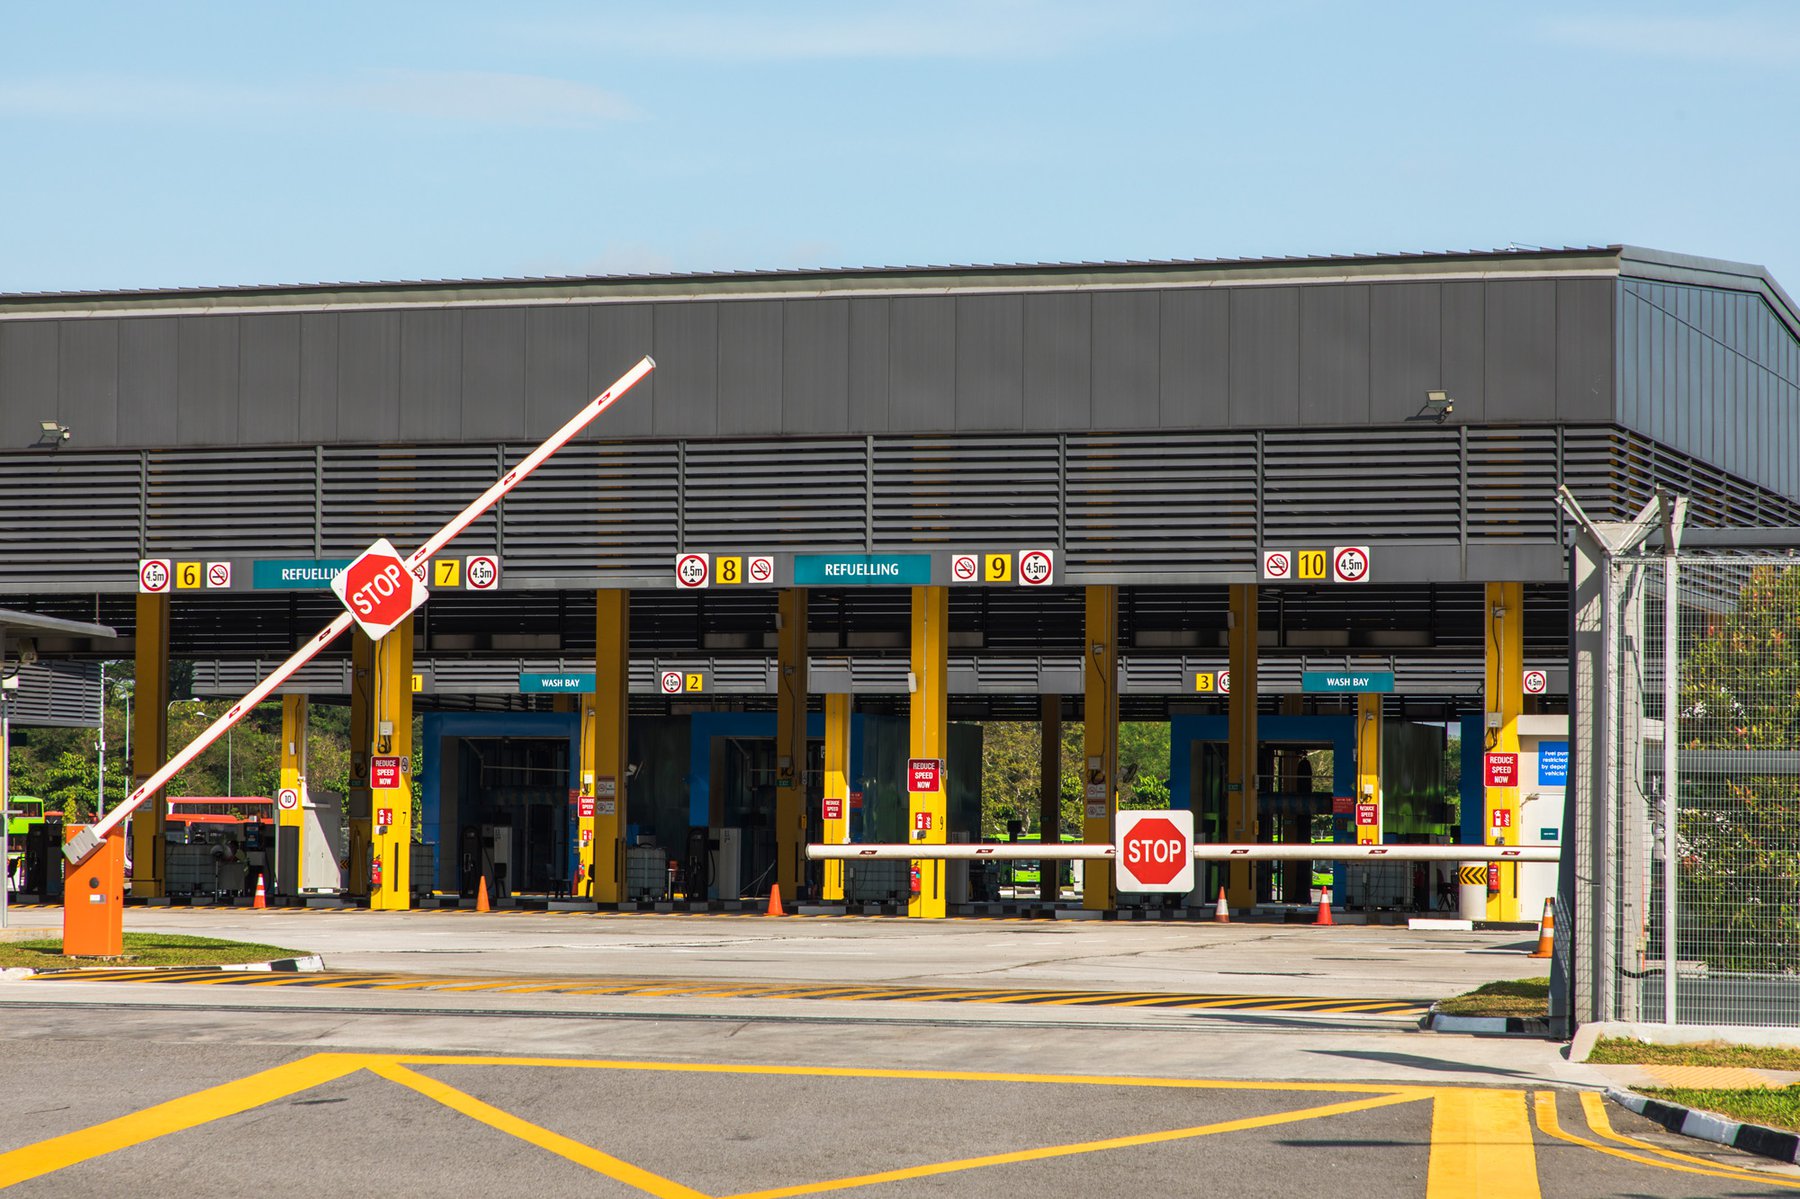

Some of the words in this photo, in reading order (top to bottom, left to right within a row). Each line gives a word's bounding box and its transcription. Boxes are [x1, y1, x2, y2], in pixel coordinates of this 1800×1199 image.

[722, 560, 736, 581] 8
[825, 563, 899, 576] REFUELLING
[992, 557, 1006, 579] 9
[1026, 562, 1047, 574] 4.5m
[1301, 554, 1324, 576] 10
[1341, 559, 1363, 570] 4.5m
[146, 568, 165, 582] 4.5m
[183, 565, 195, 586] 6
[281, 568, 343, 580] REFUELLIN
[441, 563, 454, 583] 7
[472, 567, 492, 579] 4.5m
[682, 565, 703, 577] 4.5m
[352, 564, 401, 615] STOP
[541, 679, 564, 687] WASH
[566, 679, 580, 687] BAY
[690, 675, 699, 689] 2
[1200, 675, 1209, 690] 3
[1327, 678, 1350, 687] WASH
[1353, 678, 1369, 687] BAY
[1528, 679, 1543, 687] 4.5m
[913, 762, 935, 770] REDUCE
[1489, 756, 1514, 764] REDUCE
[1491, 766, 1512, 774] SPEED
[917, 781, 931, 789] NOW
[1494, 776, 1509, 784] NOW
[1128, 839, 1182, 863] STOP
